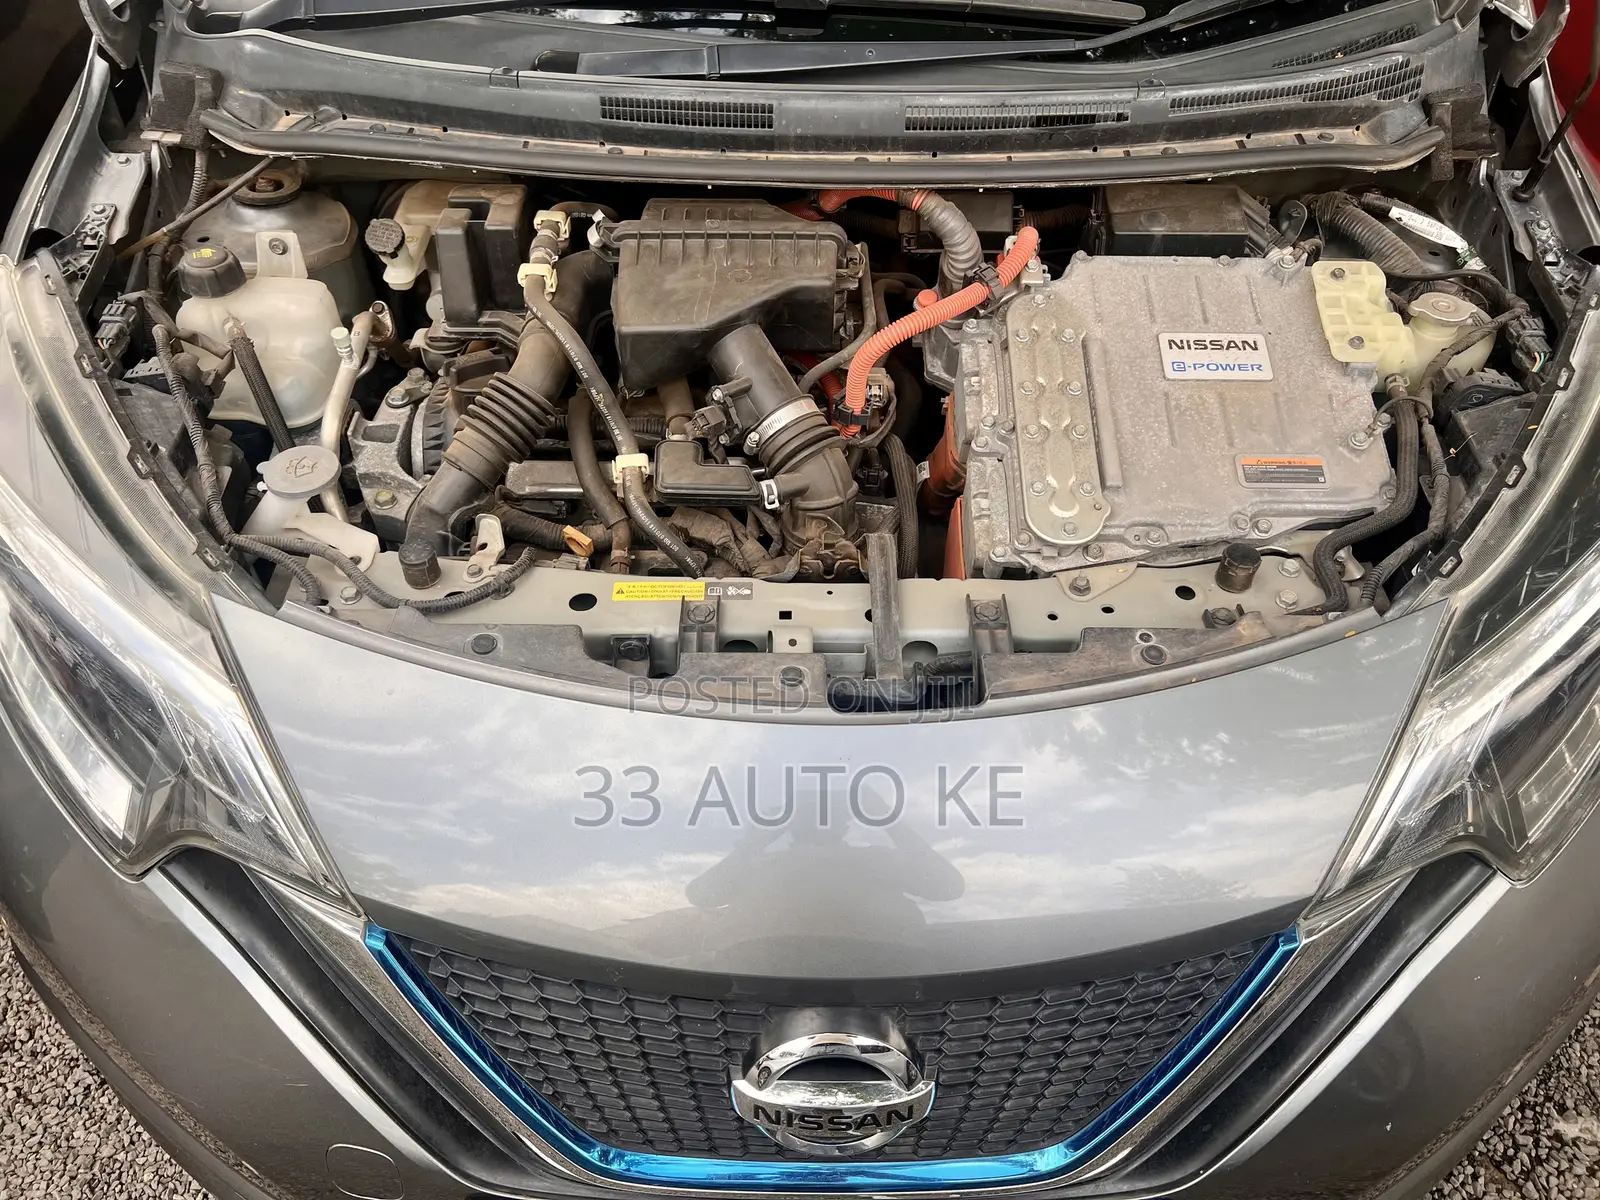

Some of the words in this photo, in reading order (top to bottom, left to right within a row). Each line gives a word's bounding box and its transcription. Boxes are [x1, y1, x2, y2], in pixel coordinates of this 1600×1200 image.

[1167, 339, 1259, 351] NISSAN
[1172, 361, 1264, 372] e-POWER
[753, 1104, 914, 1132] NISSAN
